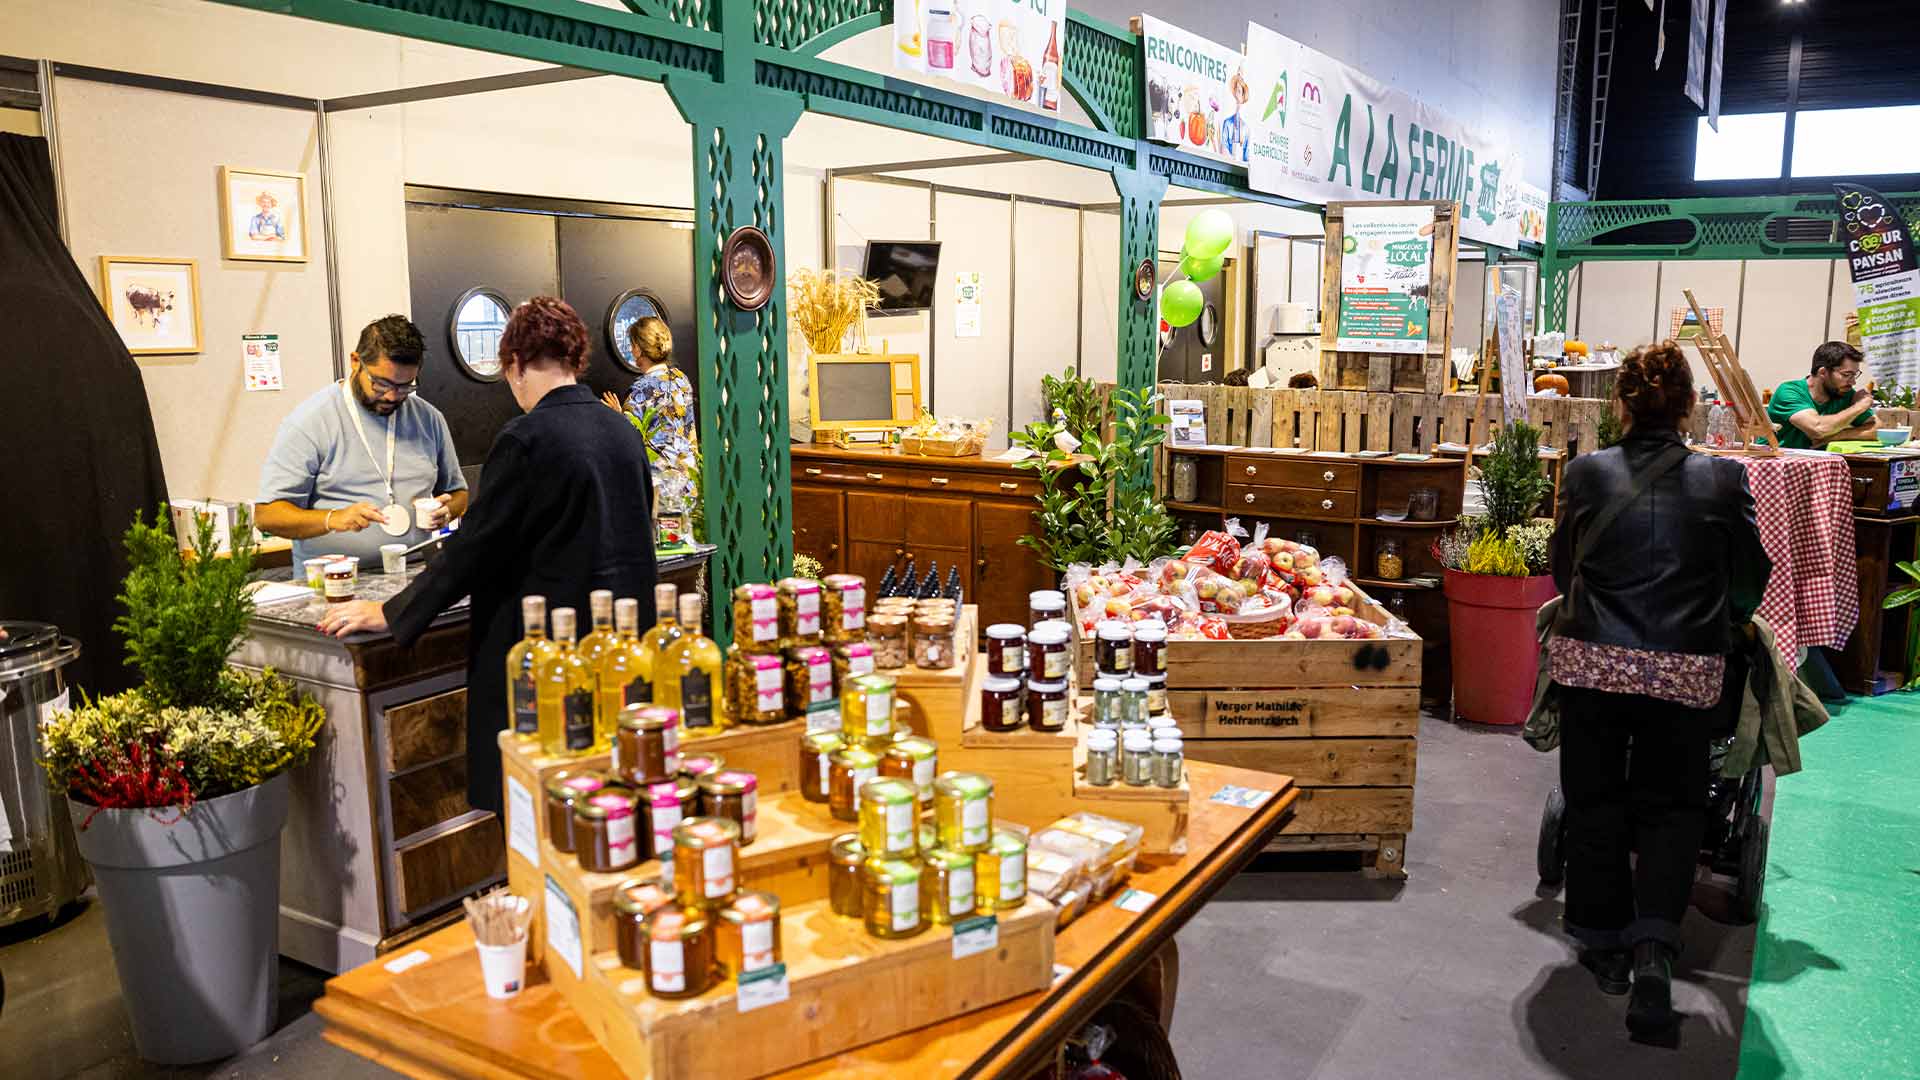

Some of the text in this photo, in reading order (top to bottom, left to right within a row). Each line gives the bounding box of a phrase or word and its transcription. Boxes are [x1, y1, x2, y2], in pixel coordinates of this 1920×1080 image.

[1147, 36, 1227, 83] RENCONTRES
[1361, 104, 1399, 198] LA
[1404, 122, 1474, 219] FERME
[1391, 250, 1425, 262] LOCAL
[1852, 248, 1904, 270] PAYSAN
[1857, 283, 1874, 295] 75
[1215, 700, 1303, 712] Verger Mathilde
